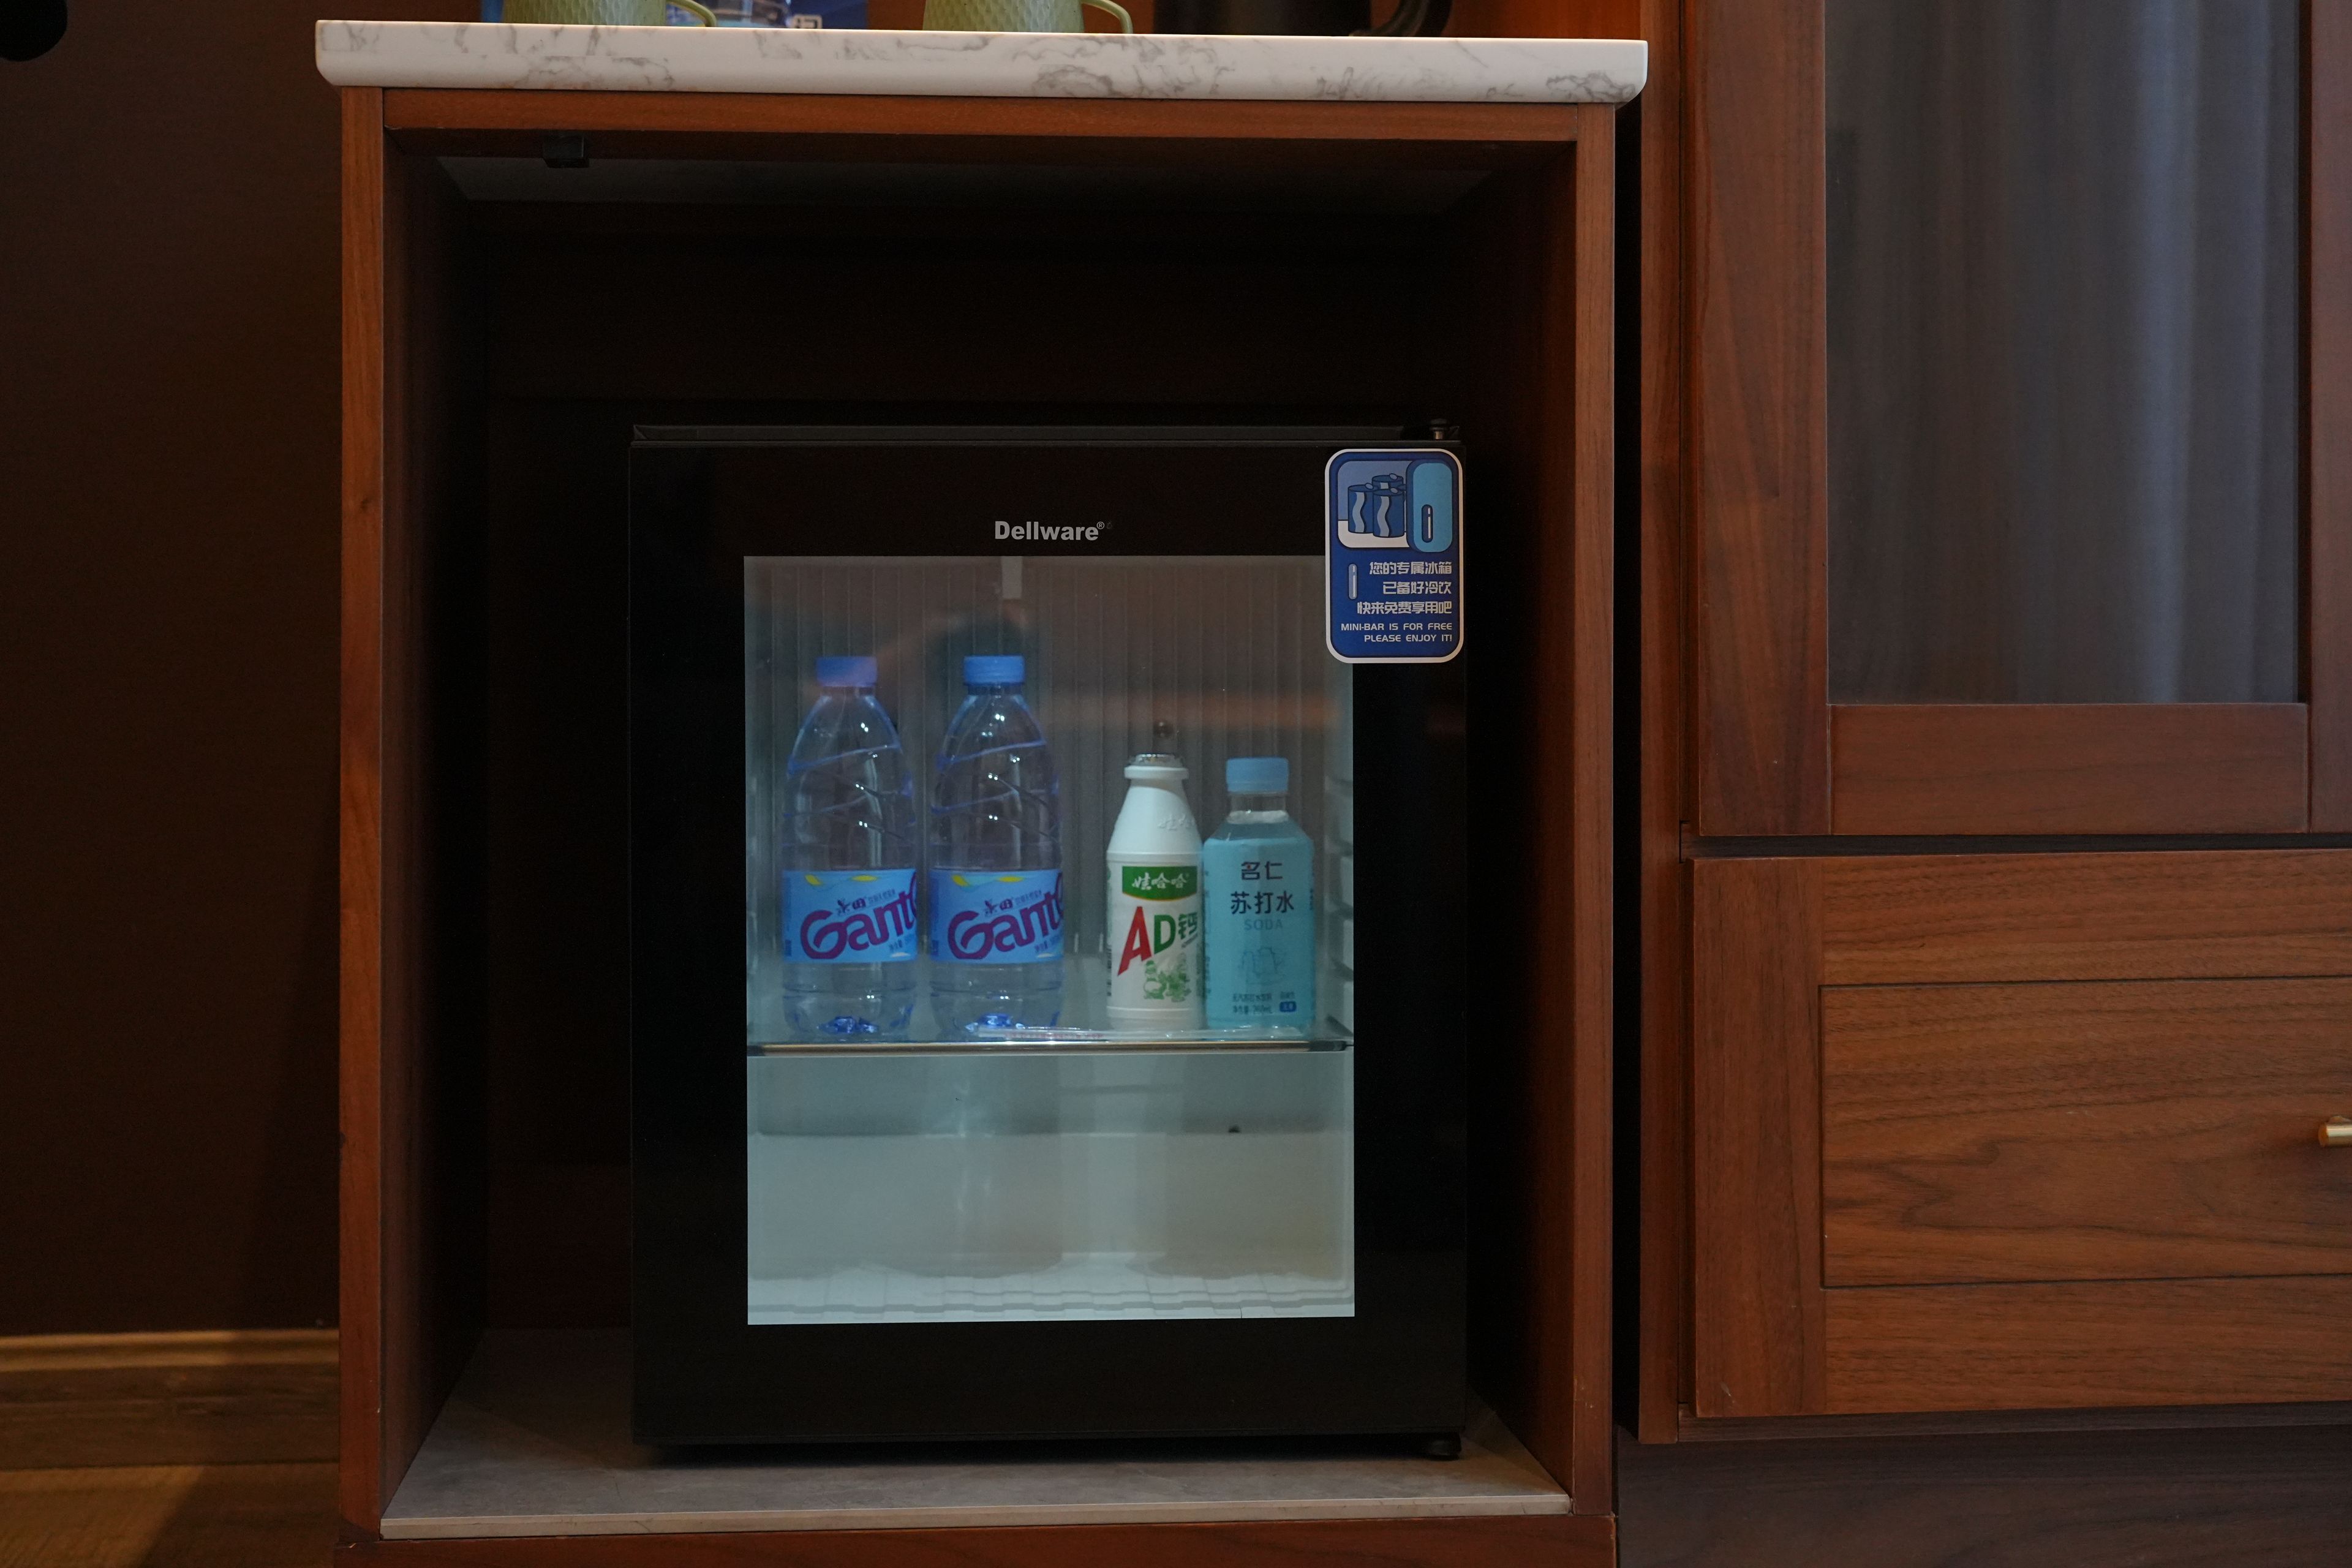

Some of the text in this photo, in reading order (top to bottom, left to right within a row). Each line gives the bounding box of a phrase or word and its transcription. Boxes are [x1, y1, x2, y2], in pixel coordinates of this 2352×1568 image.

[1370, 562, 1452, 575] 您的专属冰箱
[1383, 581, 1452, 594] 已备好冷饮
[1357, 601, 1452, 614] 快来免费享用吧
[1241, 861, 1283, 880] 名仁
[1132, 872, 1188, 891] 娃哈哈
[1231, 891, 1294, 914] 苏打水
[1244, 919, 1284, 931] SODA
